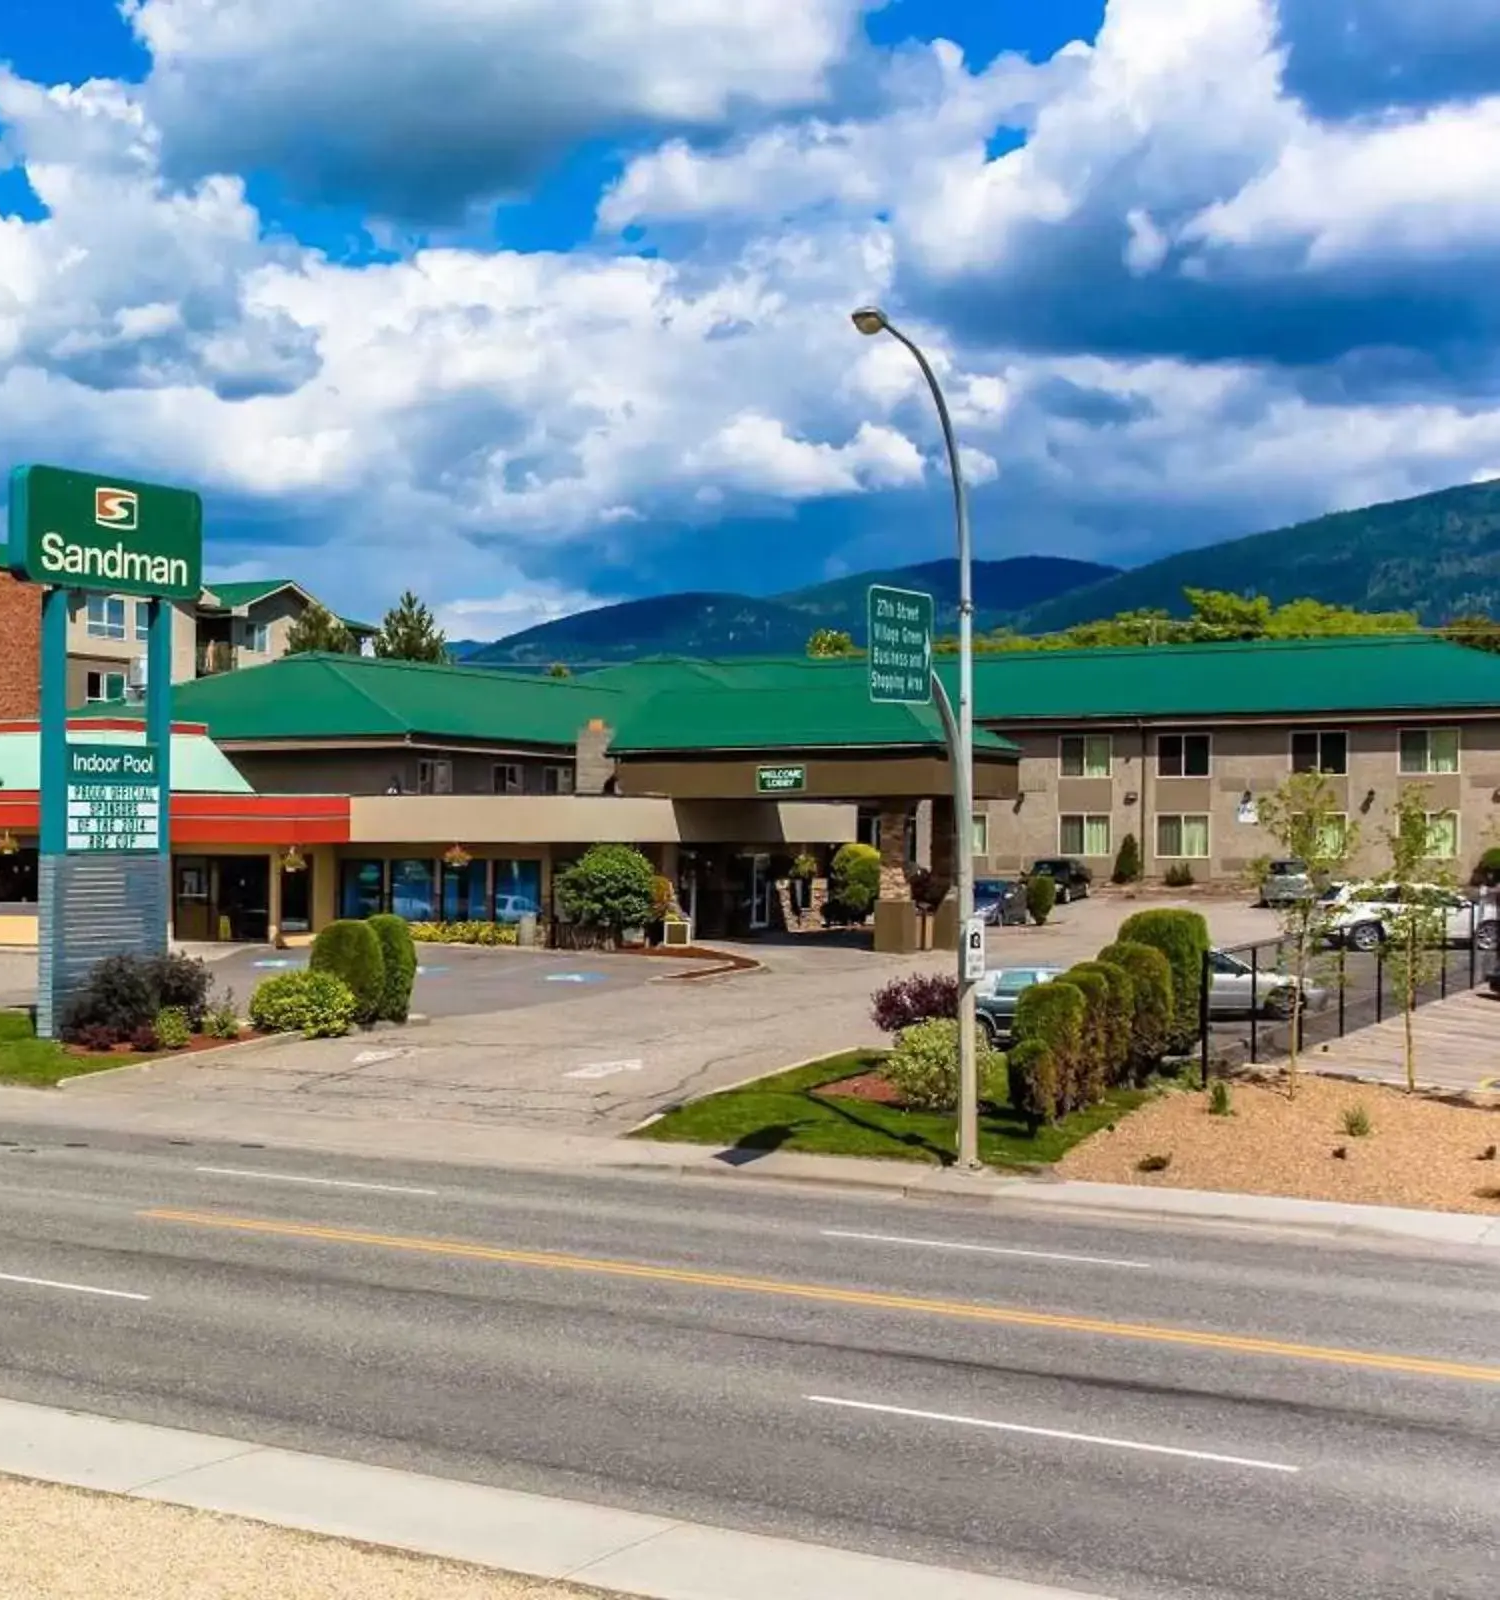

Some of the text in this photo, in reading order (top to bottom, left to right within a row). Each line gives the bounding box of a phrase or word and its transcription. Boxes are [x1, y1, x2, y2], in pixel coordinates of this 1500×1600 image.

[40, 532, 189, 587] Sandman
[896, 601, 920, 621] Street
[874, 622, 900, 647] Village
[873, 647, 923, 669] Business and
[871, 669, 923, 694] Shopping Area
[73, 752, 154, 773] Indoor Pool
[759, 769, 803, 779] WELCOME
[766, 778, 795, 788] LOBBY
[73, 786, 154, 801] PROUD OFFICIAL
[77, 819, 146, 833] OF THE 2014
